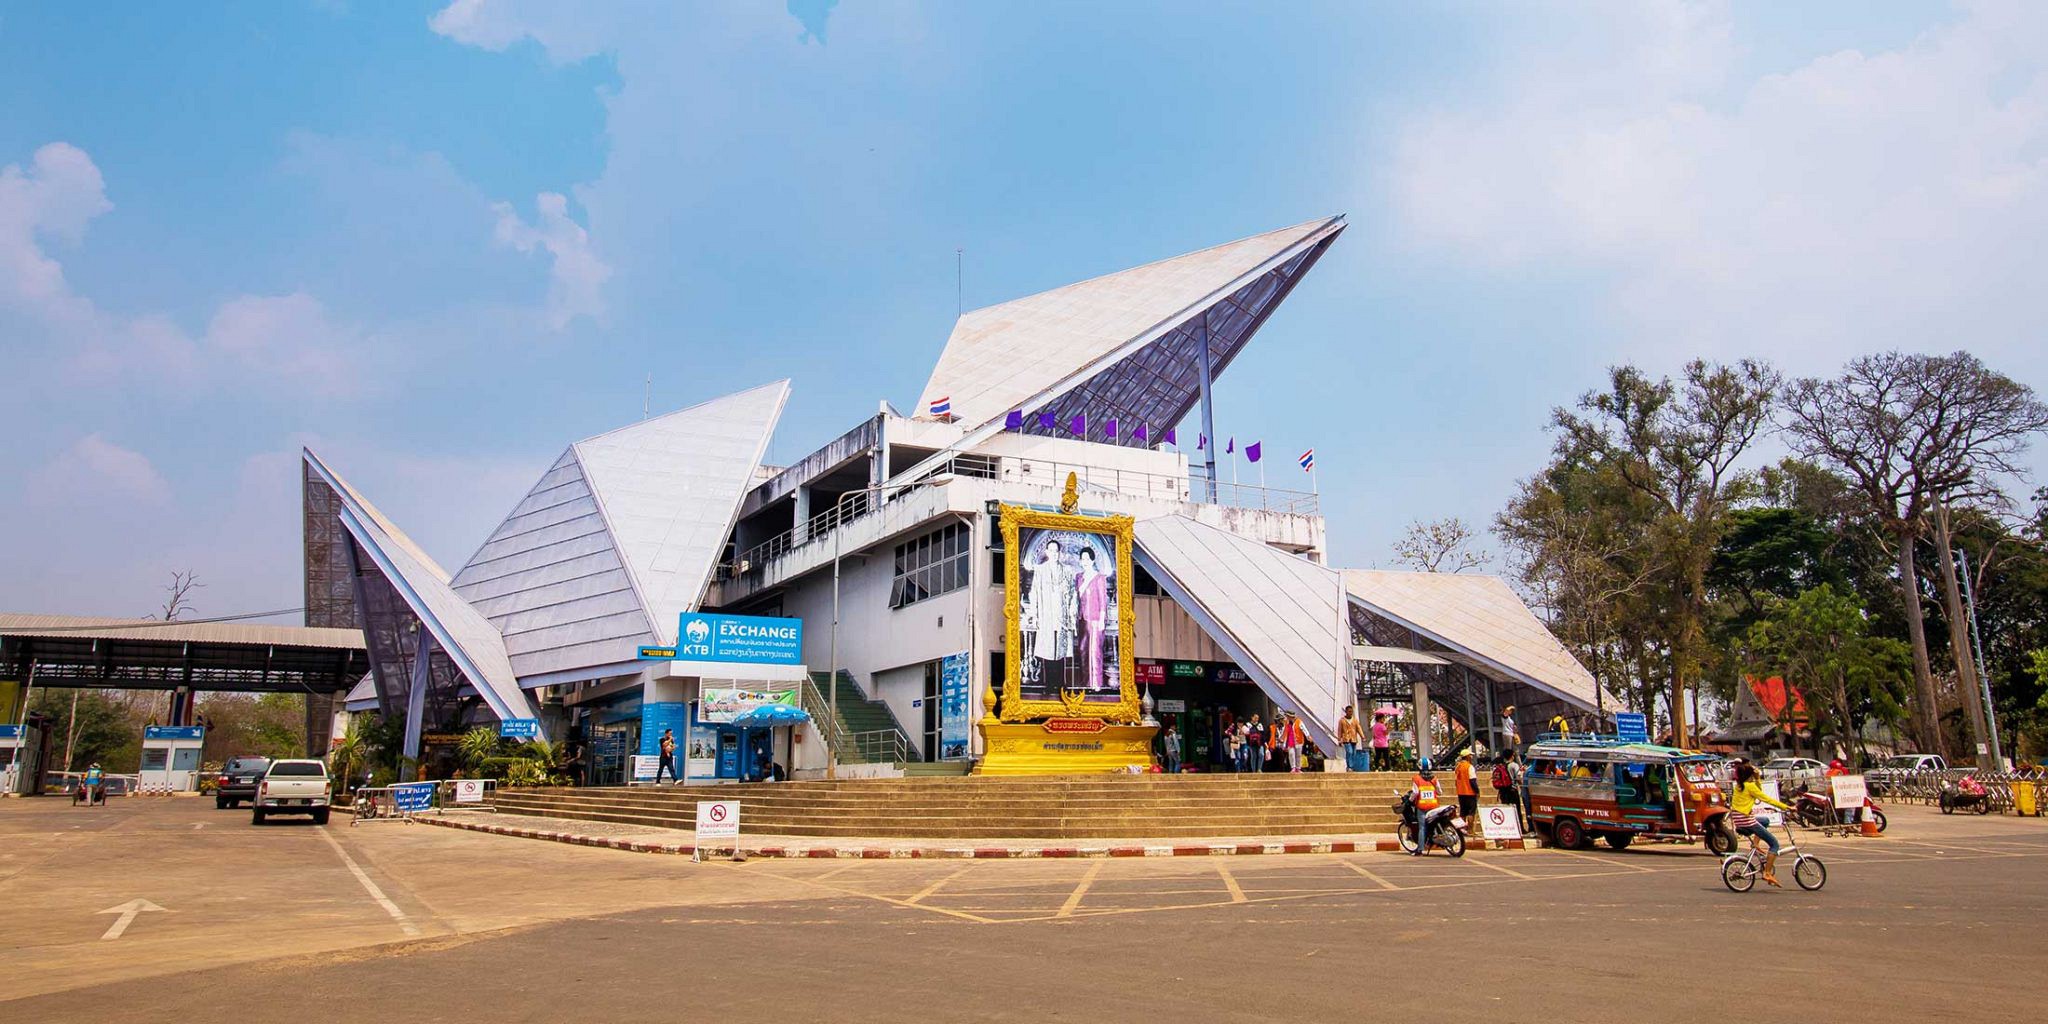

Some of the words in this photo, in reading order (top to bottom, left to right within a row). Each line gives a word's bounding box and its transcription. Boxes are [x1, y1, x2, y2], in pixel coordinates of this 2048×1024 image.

[720, 624, 797, 639] EXCHANGE
[683, 644, 709, 655] KTB
[1147, 665, 1164, 674] ATM
[1229, 671, 1246, 679] ATM
[1584, 808, 1595, 816] TIP
